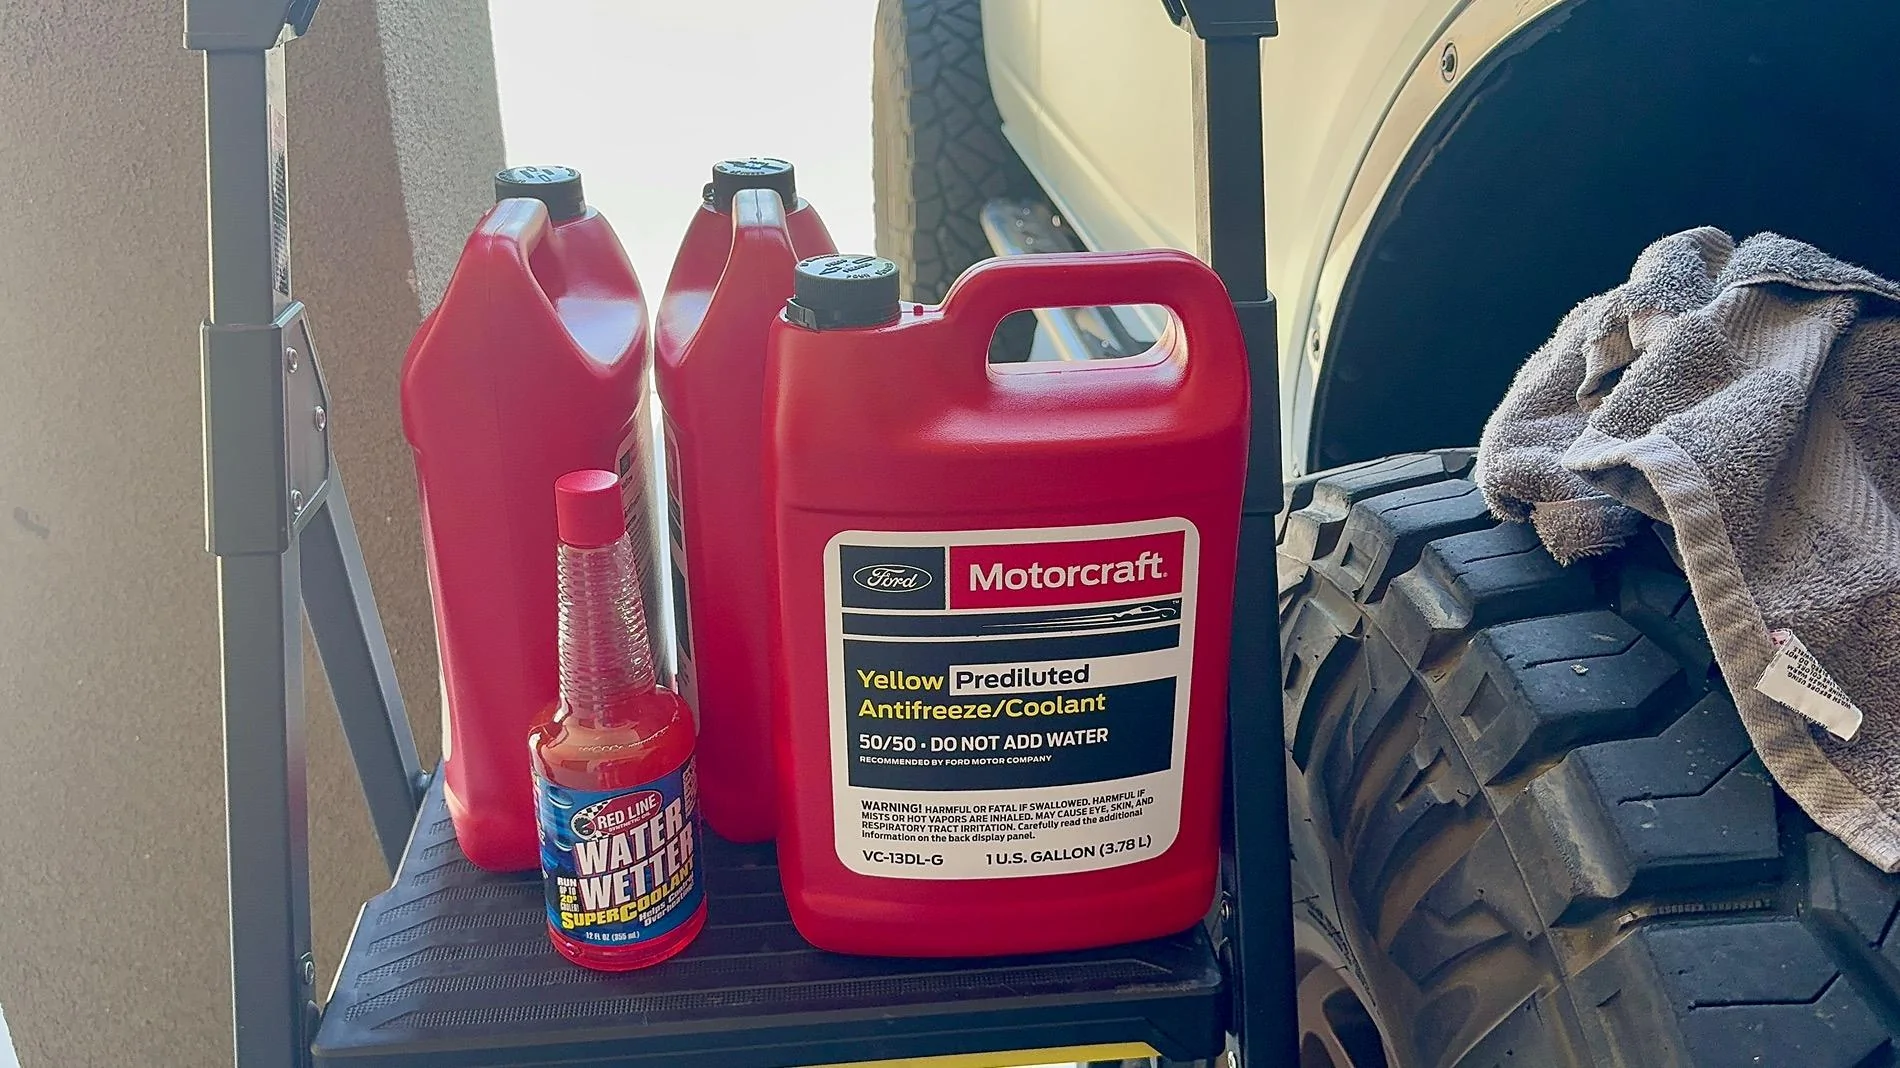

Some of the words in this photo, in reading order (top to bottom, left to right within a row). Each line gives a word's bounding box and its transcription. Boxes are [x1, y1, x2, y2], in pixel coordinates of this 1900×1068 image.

[867, 567, 918, 588] Ford
[1785, 650, 1798, 660] NOT
[1799, 657, 1810, 666] DO
[857, 669, 944, 690] Yellow
[956, 663, 1090, 690] Prediluted
[1809, 676, 1828, 690] WASH
[1806, 682, 1833, 700] BEFORE
[858, 693, 1106, 720] Antifreeze/Coolant
[1832, 695, 1852, 710] WASH
[859, 733, 917, 752] 50/50
[930, 736, 957, 752] DO
[961, 735, 1000, 751] NOT
[1004, 733, 1043, 750] ADD
[1046, 727, 1109, 748] WATER
[859, 755, 930, 766] RECOMMENDED
[945, 758, 971, 766] FORD
[971, 757, 1005, 765] MOTOR
[1006, 754, 1052, 764] COMPANY
[597, 810, 625, 830] RED
[627, 793, 657, 820] LINE
[861, 800, 922, 814] WARNING!
[925, 805, 972, 814] HARMFUL
[973, 805, 987, 813] OR
[988, 804, 1017, 813] FATAL
[1019, 803, 1028, 811] IF
[1029, 799, 1091, 811] SWALLOWED.
[1092, 790, 1136, 804] HARMFUL
[1137, 788, 1146, 798] IF
[861, 812, 890, 821] MISTS
[891, 814, 906, 823] OR
[907, 815, 927, 823] HOT
[928, 815, 968, 824] VAPORS
[969, 814, 988, 823] ARE
[990, 812, 1033, 823] INHALED.
[1035, 810, 1056, 820] MAY
[1057, 807, 1088, 819] CAUSE
[1089, 804, 1109, 816] EYE,
[1110, 802, 1134, 812] SKIN,
[1135, 796, 1154, 807] AND
[861, 821, 926, 833] RESPIRATORY
[927, 824, 959, 833] TRACT
[960, 822, 1016, 833] IRRITATION.
[1017, 818, 1059, 831] Carefully
[1060, 818, 1081, 828] read
[1082, 816, 1097, 825] the
[1099, 808, 1143, 823] additional
[575, 797, 683, 876] WATER
[930, 834, 947, 842] the
[948, 833, 971, 842] back
[971, 832, 1005, 843] display
[1006, 831, 1036, 842] panel.
[862, 849, 944, 866] VC-13DL-G
[986, 853, 992, 865] 1
[995, 852, 1028, 865] U.S.
[1030, 845, 1096, 862] GALLON
[1099, 838, 1136, 858] (3.78
[1138, 834, 1152, 849] L)
[579, 821, 694, 911] WETTER
[557, 876, 577, 887] RUN
[638, 900, 666, 922] Helps
[586, 931, 594, 940] 12
[594, 932, 602, 940] FL
